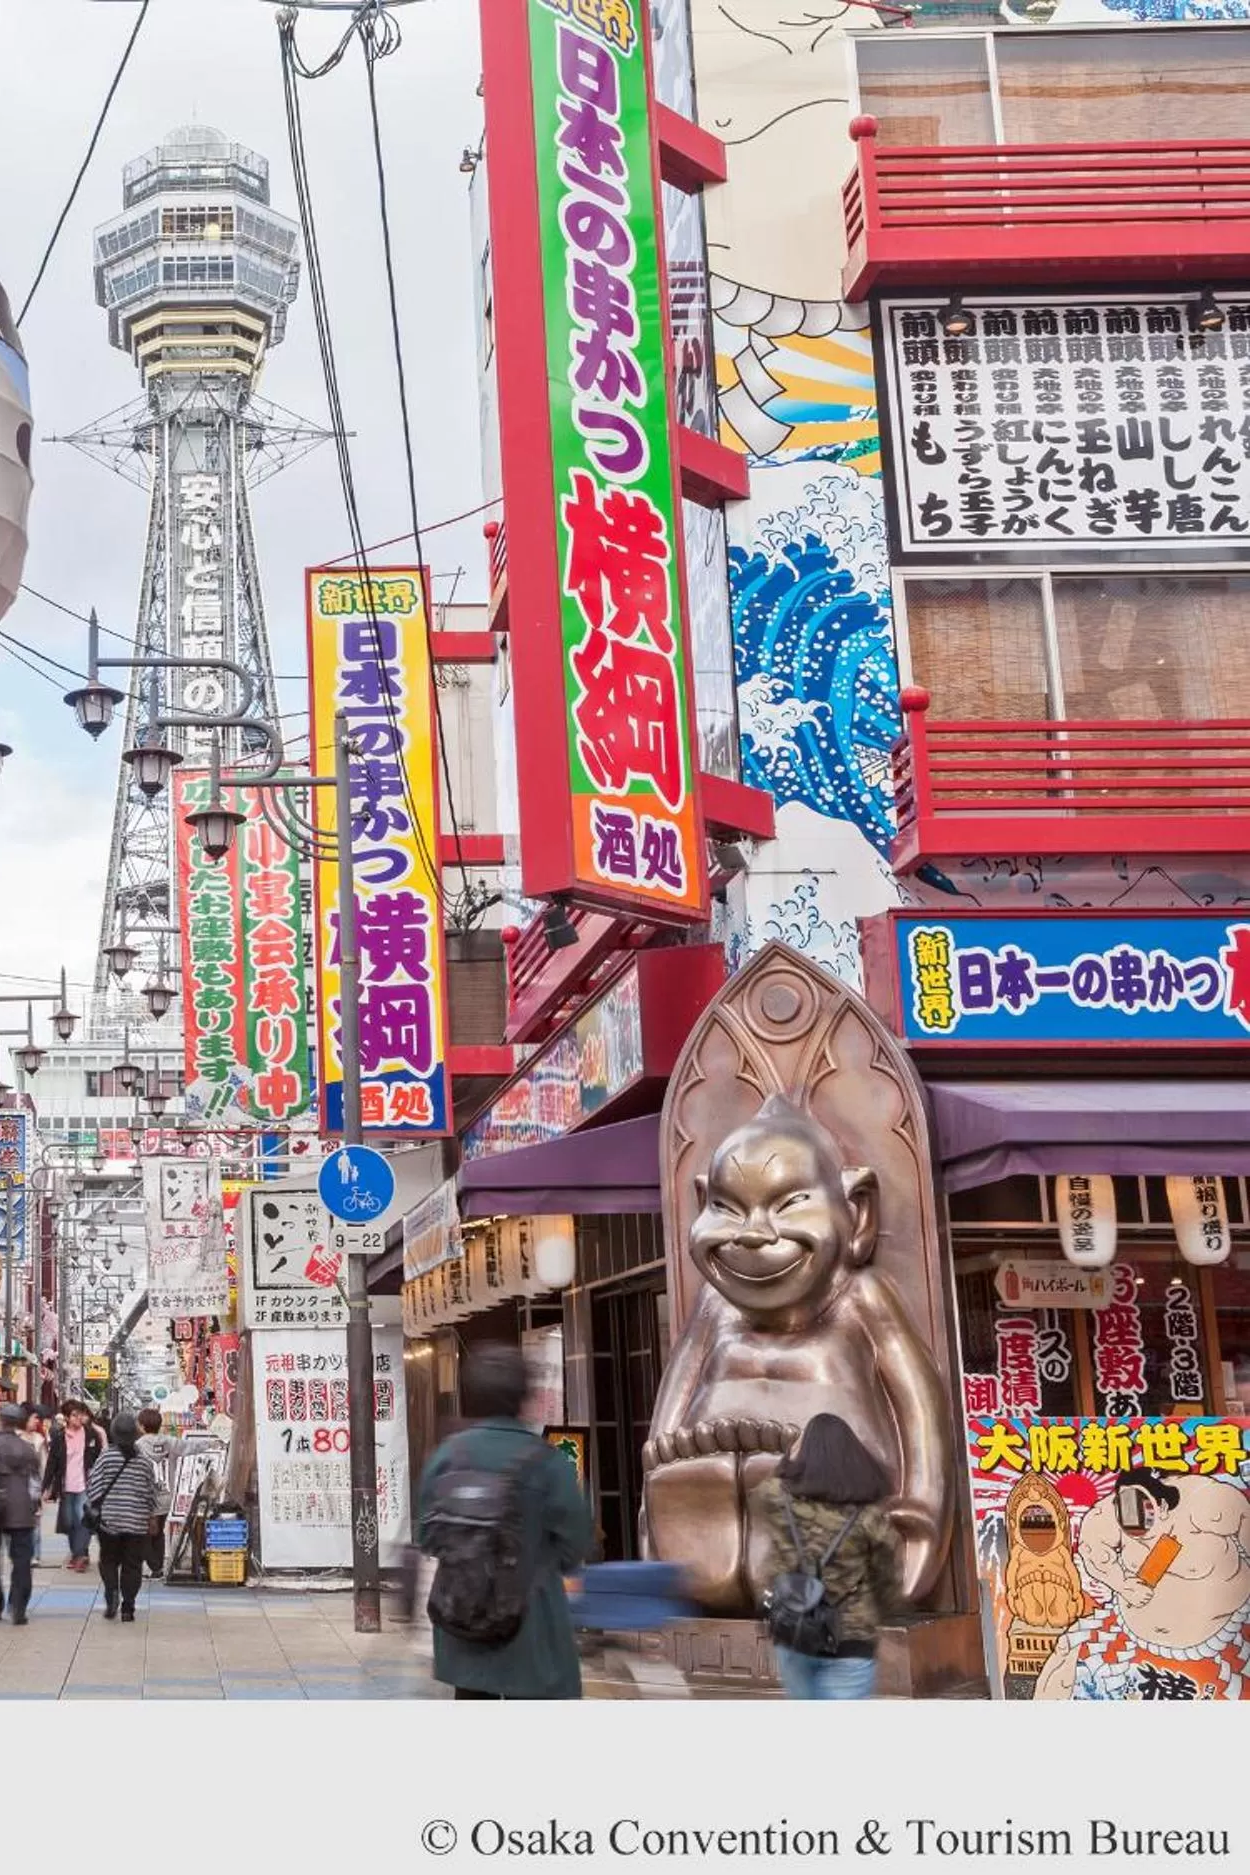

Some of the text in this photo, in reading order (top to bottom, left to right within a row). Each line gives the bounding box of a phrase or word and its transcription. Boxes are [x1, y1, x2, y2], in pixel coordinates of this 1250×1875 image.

[558, 26, 682, 803] 日本一の串かつ 横綱
[992, 420, 1040, 536] 紅しょうが
[1033, 420, 1077, 536] にんにく
[1075, 418, 1122, 535] 玉ねぎ
[1116, 416, 1163, 534] 山芋
[1199, 415, 1249, 532] れんこん
[319, 580, 418, 615] 新世界
[339, 621, 410, 884] 日本一の串かつ
[593, 805, 684, 891] 酒処
[913, 927, 952, 1030] 新世界
[956, 950, 1221, 1012] 日本一の串かつ
[335, 1233, 382, 1249] 9-22
[254, 1310, 344, 1324] 2F 座敷あります
[265, 1353, 391, 1373] 元祖串カツ店
[979, 1423, 1249, 1475] 大阪新世界
